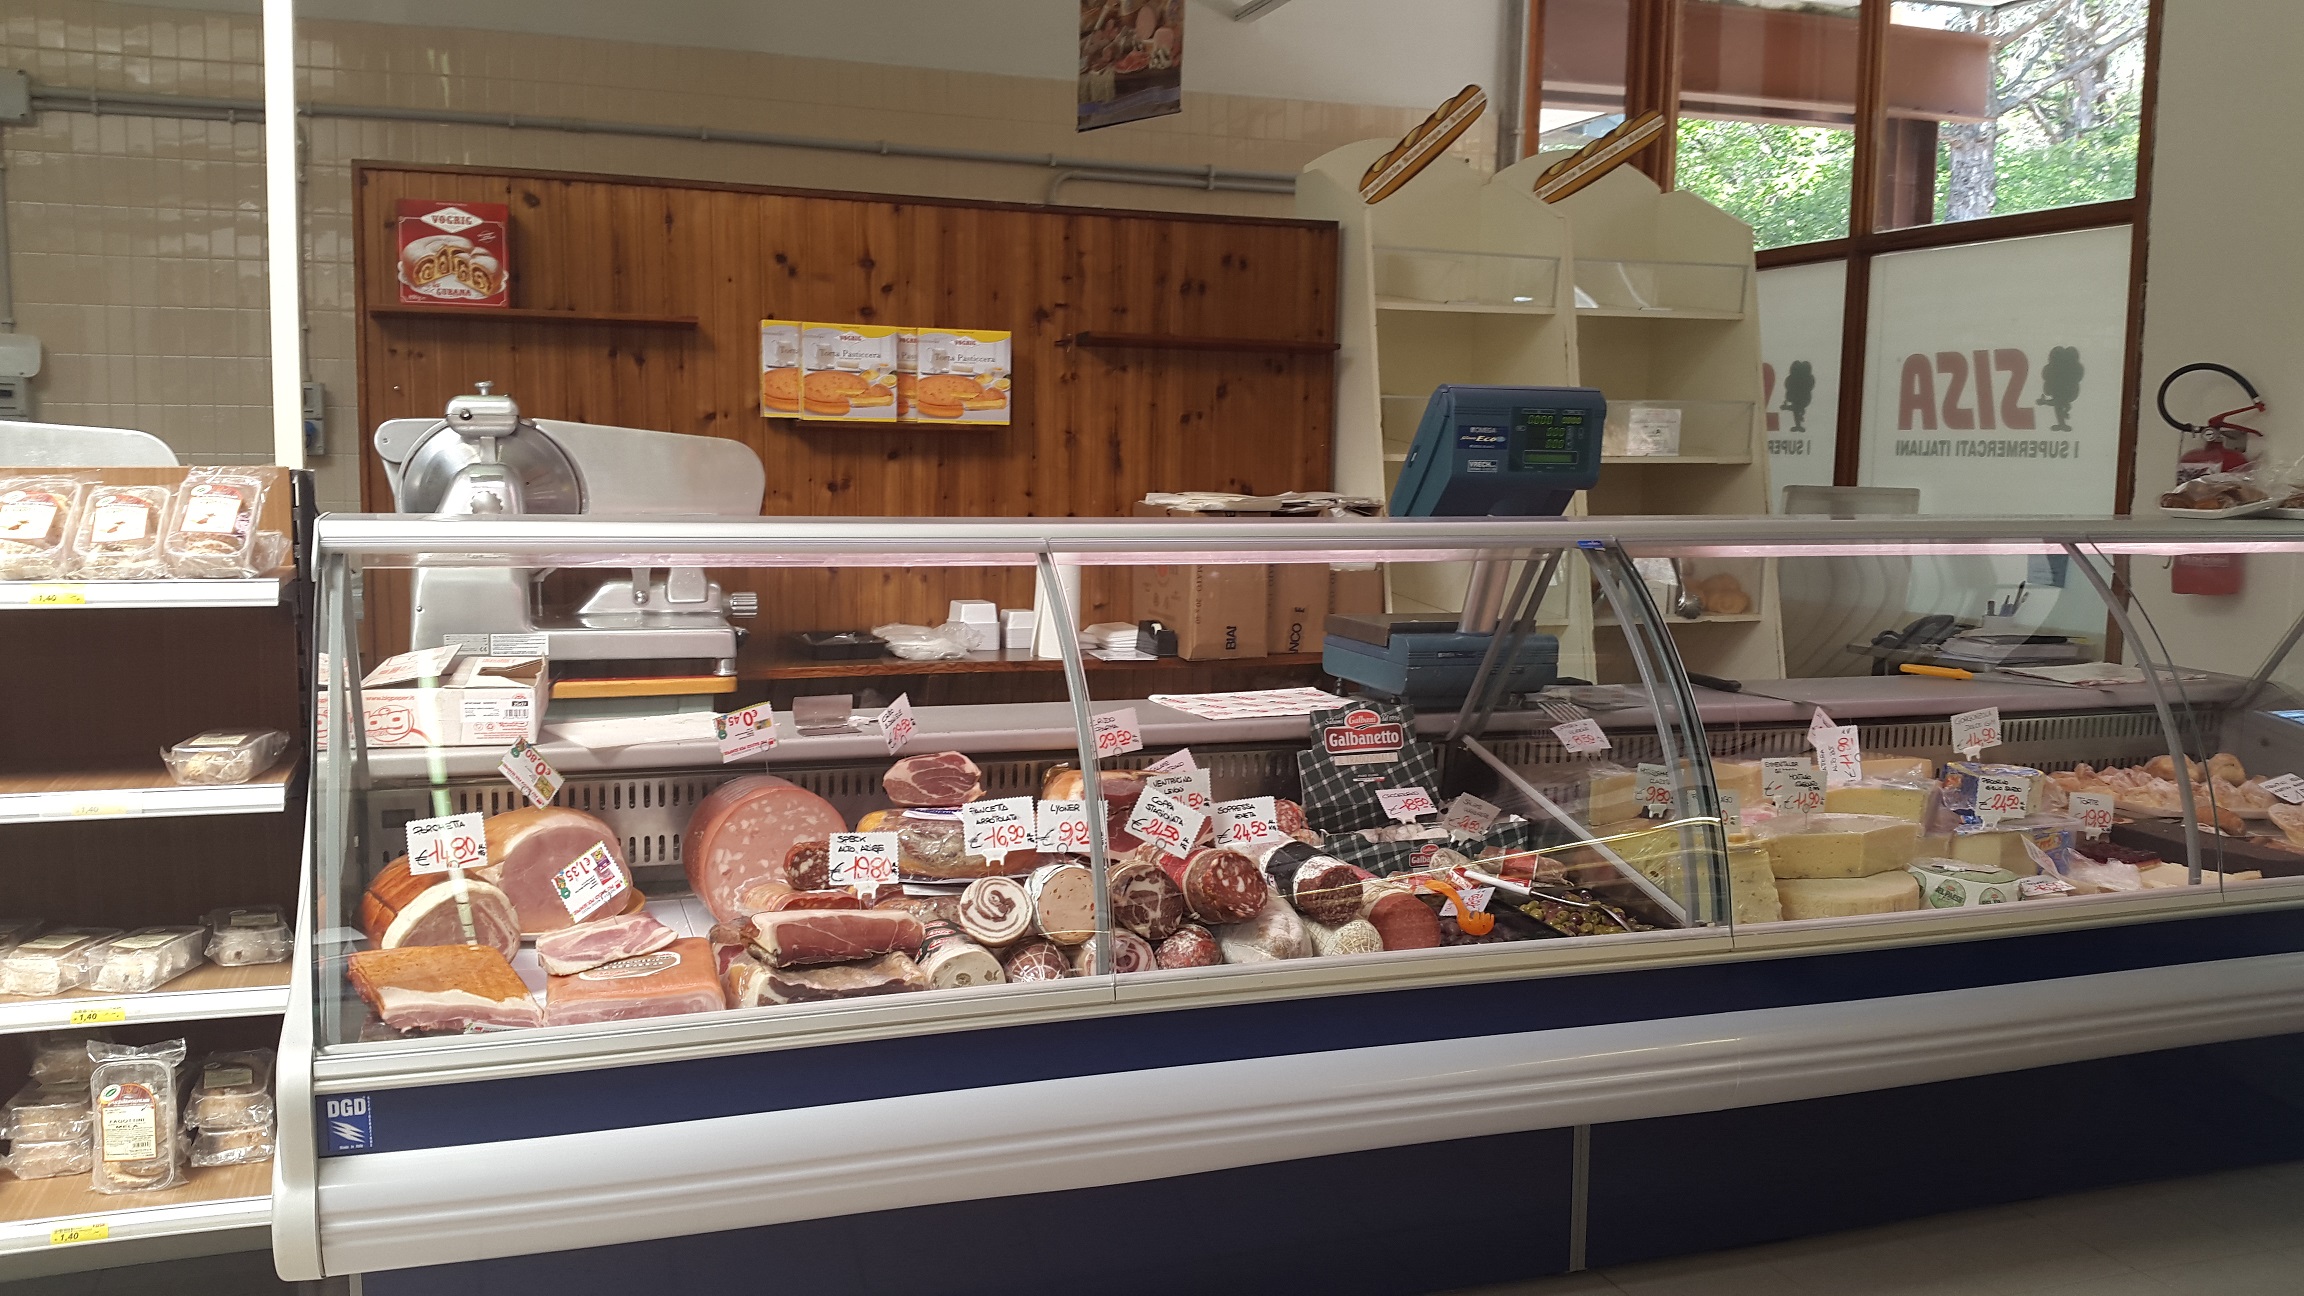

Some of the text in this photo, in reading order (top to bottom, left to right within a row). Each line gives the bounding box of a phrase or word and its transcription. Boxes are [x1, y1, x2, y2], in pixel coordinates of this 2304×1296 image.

[820, 348, 882, 360] Torta Pasticcera
[934, 352, 996, 363] Torta Pasticcera
[1348, 715, 1377, 725] Galbani
[1328, 730, 1400, 748] Galbanetto
[1050, 803, 1081, 815] LYONER
[1151, 796, 1175, 811] COPPA
[80, 1013, 98, 1022] 1,40
[327, 1097, 367, 1119] DGD
[60, 1232, 79, 1241] 1,40
